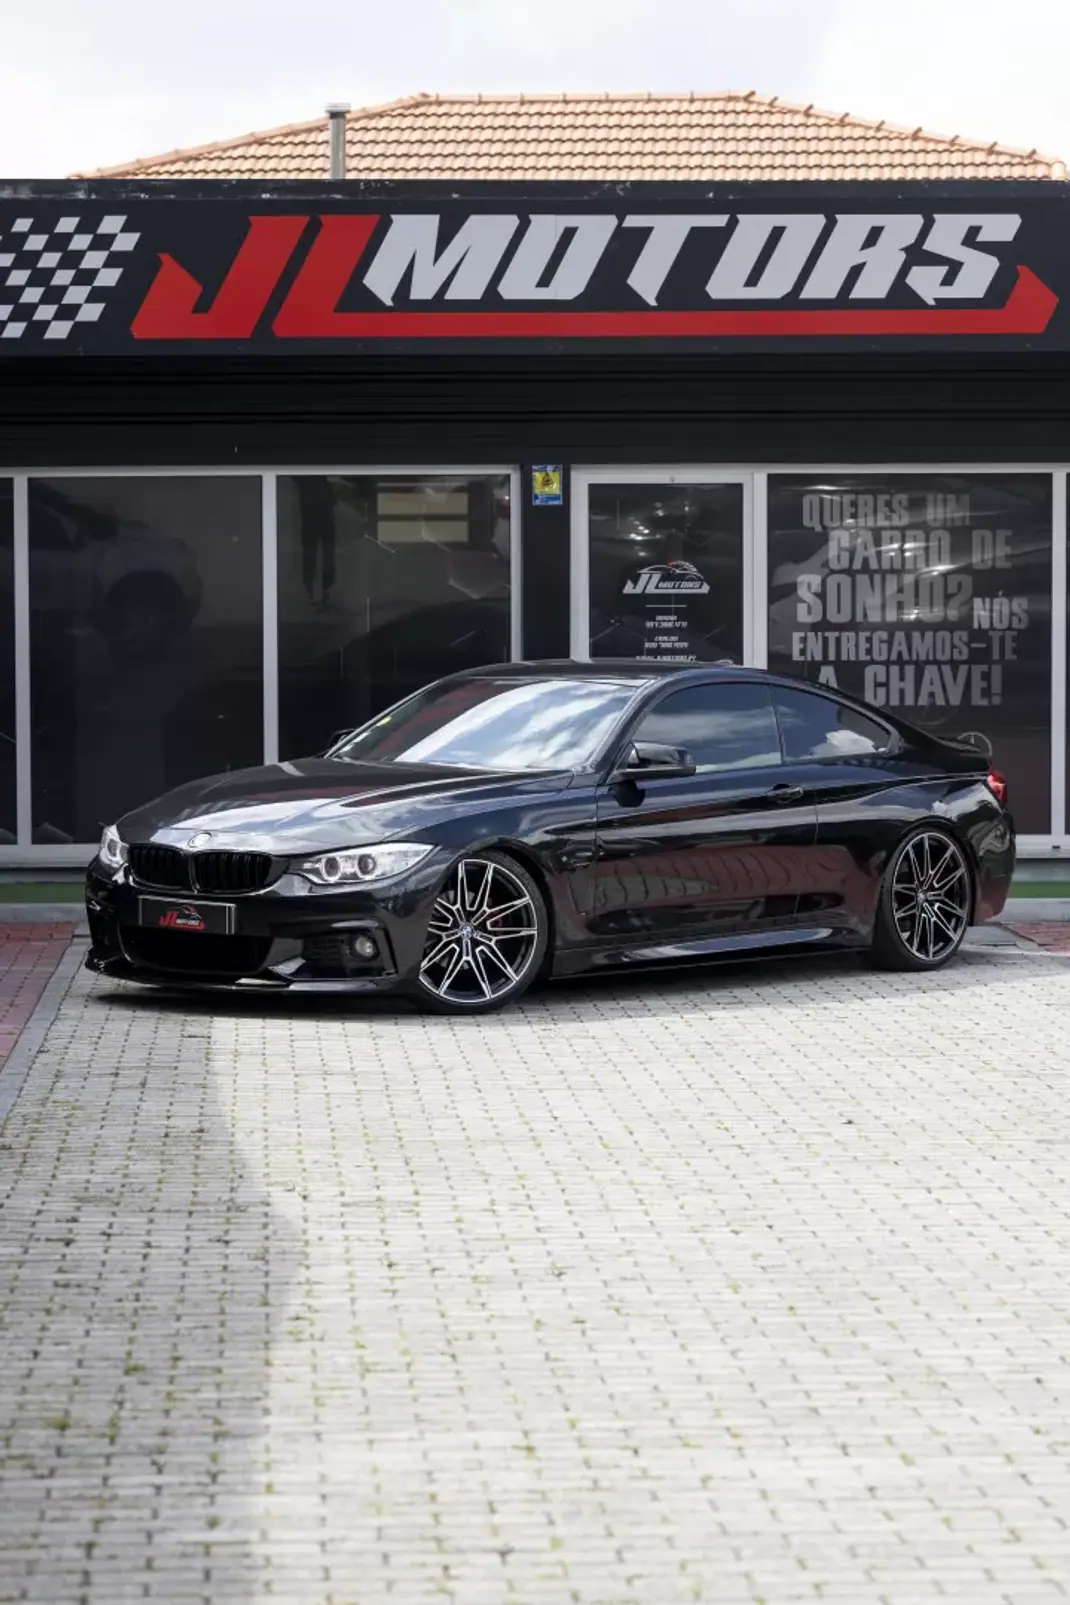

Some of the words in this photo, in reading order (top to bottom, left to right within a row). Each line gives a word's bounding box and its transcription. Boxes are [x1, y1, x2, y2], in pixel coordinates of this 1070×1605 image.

[130, 214, 381, 339] JL
[362, 213, 1022, 306] MOTORS
[802, 493, 909, 531] QUERES
[926, 493, 970, 527] UM
[828, 529, 950, 570] CARRO
[972, 529, 1012, 570] DE
[796, 573, 973, 623] SONHO?
[973, 590, 1029, 630] NÓS
[792, 631, 1018, 661] ENTREGAMOS-TE
[864, 664, 1003, 706] CHAVE!
